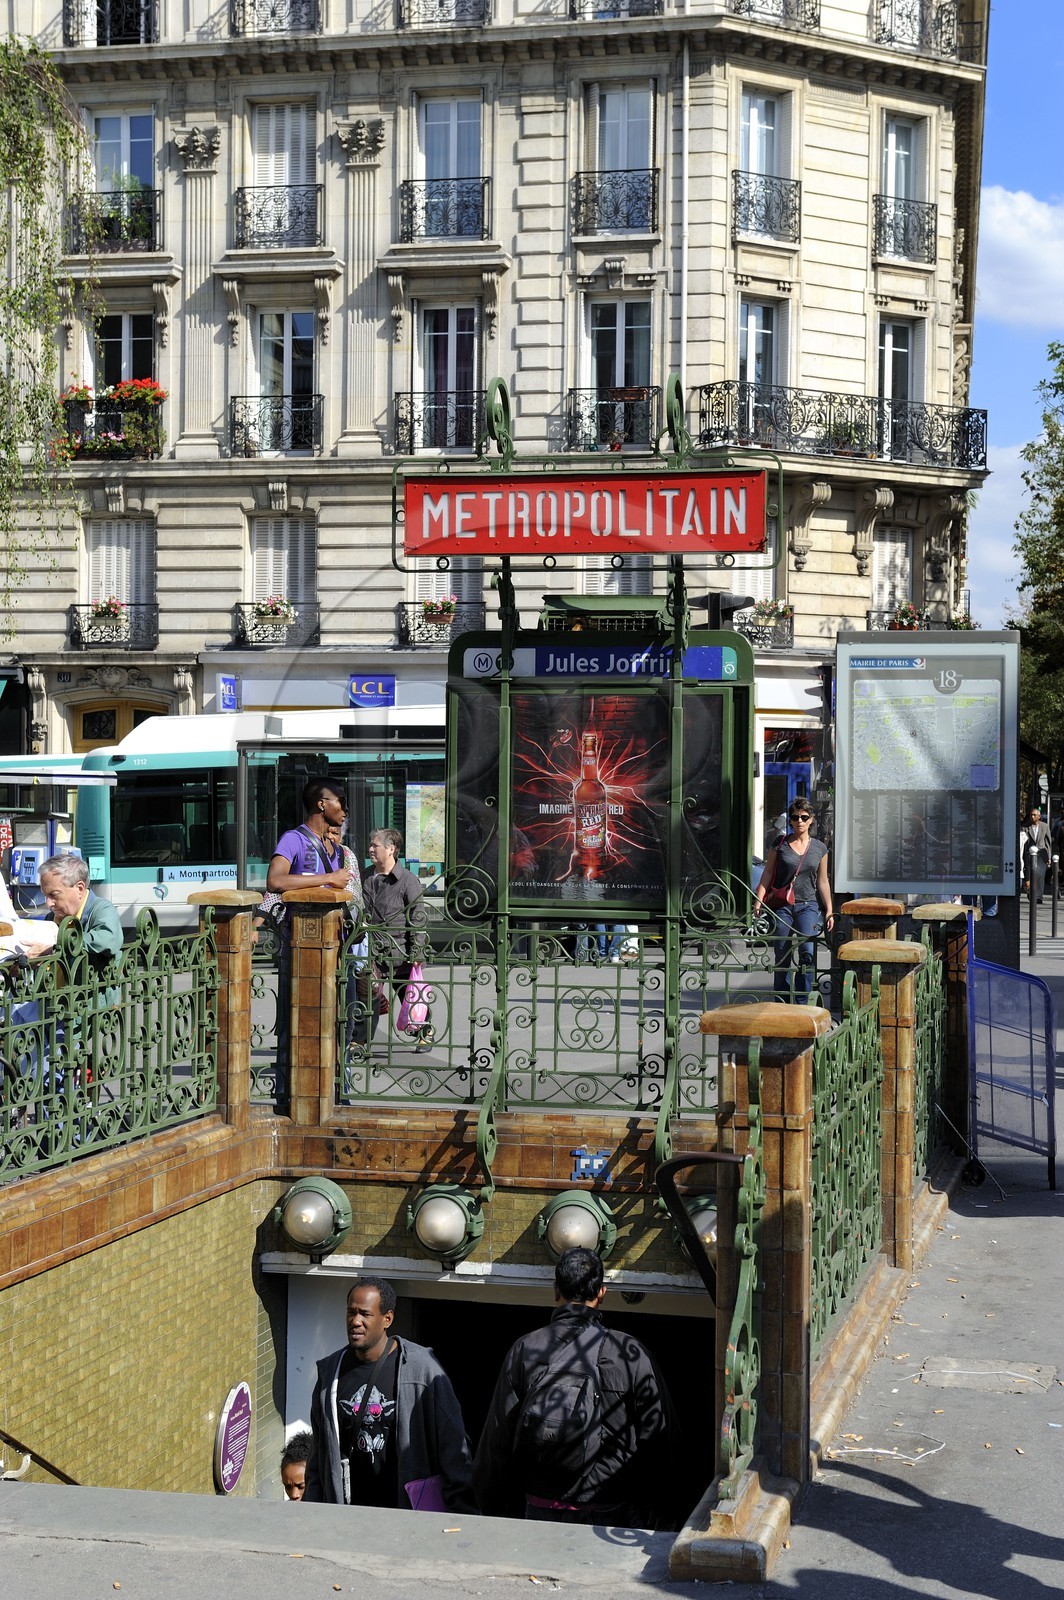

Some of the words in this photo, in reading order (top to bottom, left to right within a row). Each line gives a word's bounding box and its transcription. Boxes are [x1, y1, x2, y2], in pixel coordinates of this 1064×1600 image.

[422, 487, 747, 539] METROPOLITAIN
[545, 652, 600, 673] Jules
[58, 672, 70, 682] 30
[938, 669, 957, 688] 18
[351, 681, 390, 695] LCL
[539, 803, 573, 814] IMAGINE
[608, 804, 624, 815] RED
